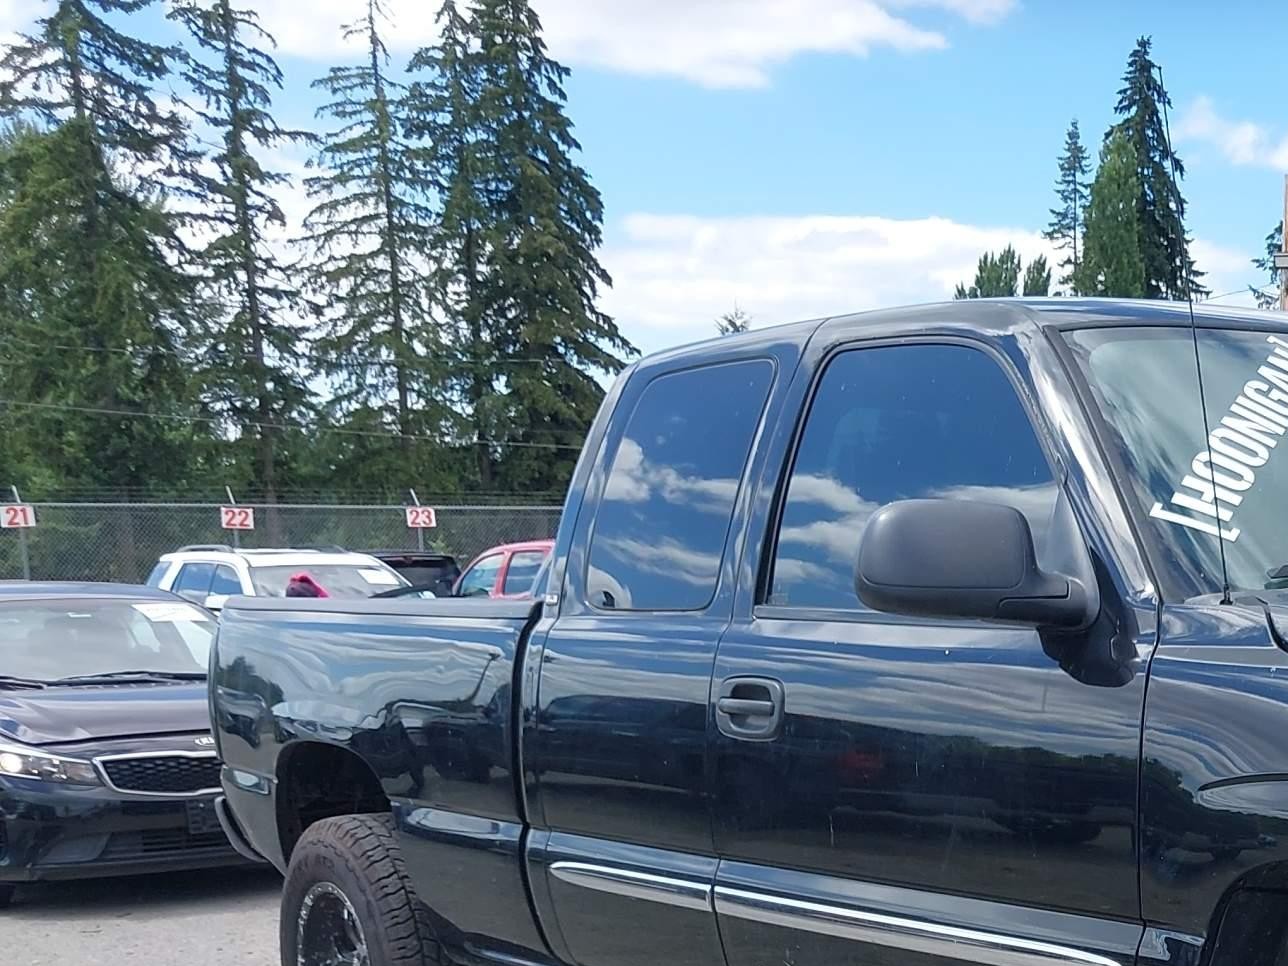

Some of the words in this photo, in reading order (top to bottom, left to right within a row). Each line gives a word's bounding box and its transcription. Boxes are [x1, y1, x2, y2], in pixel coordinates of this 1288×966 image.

[5, 507, 28, 526] 21
[224, 510, 250, 527] 22
[409, 510, 433, 526] 23
